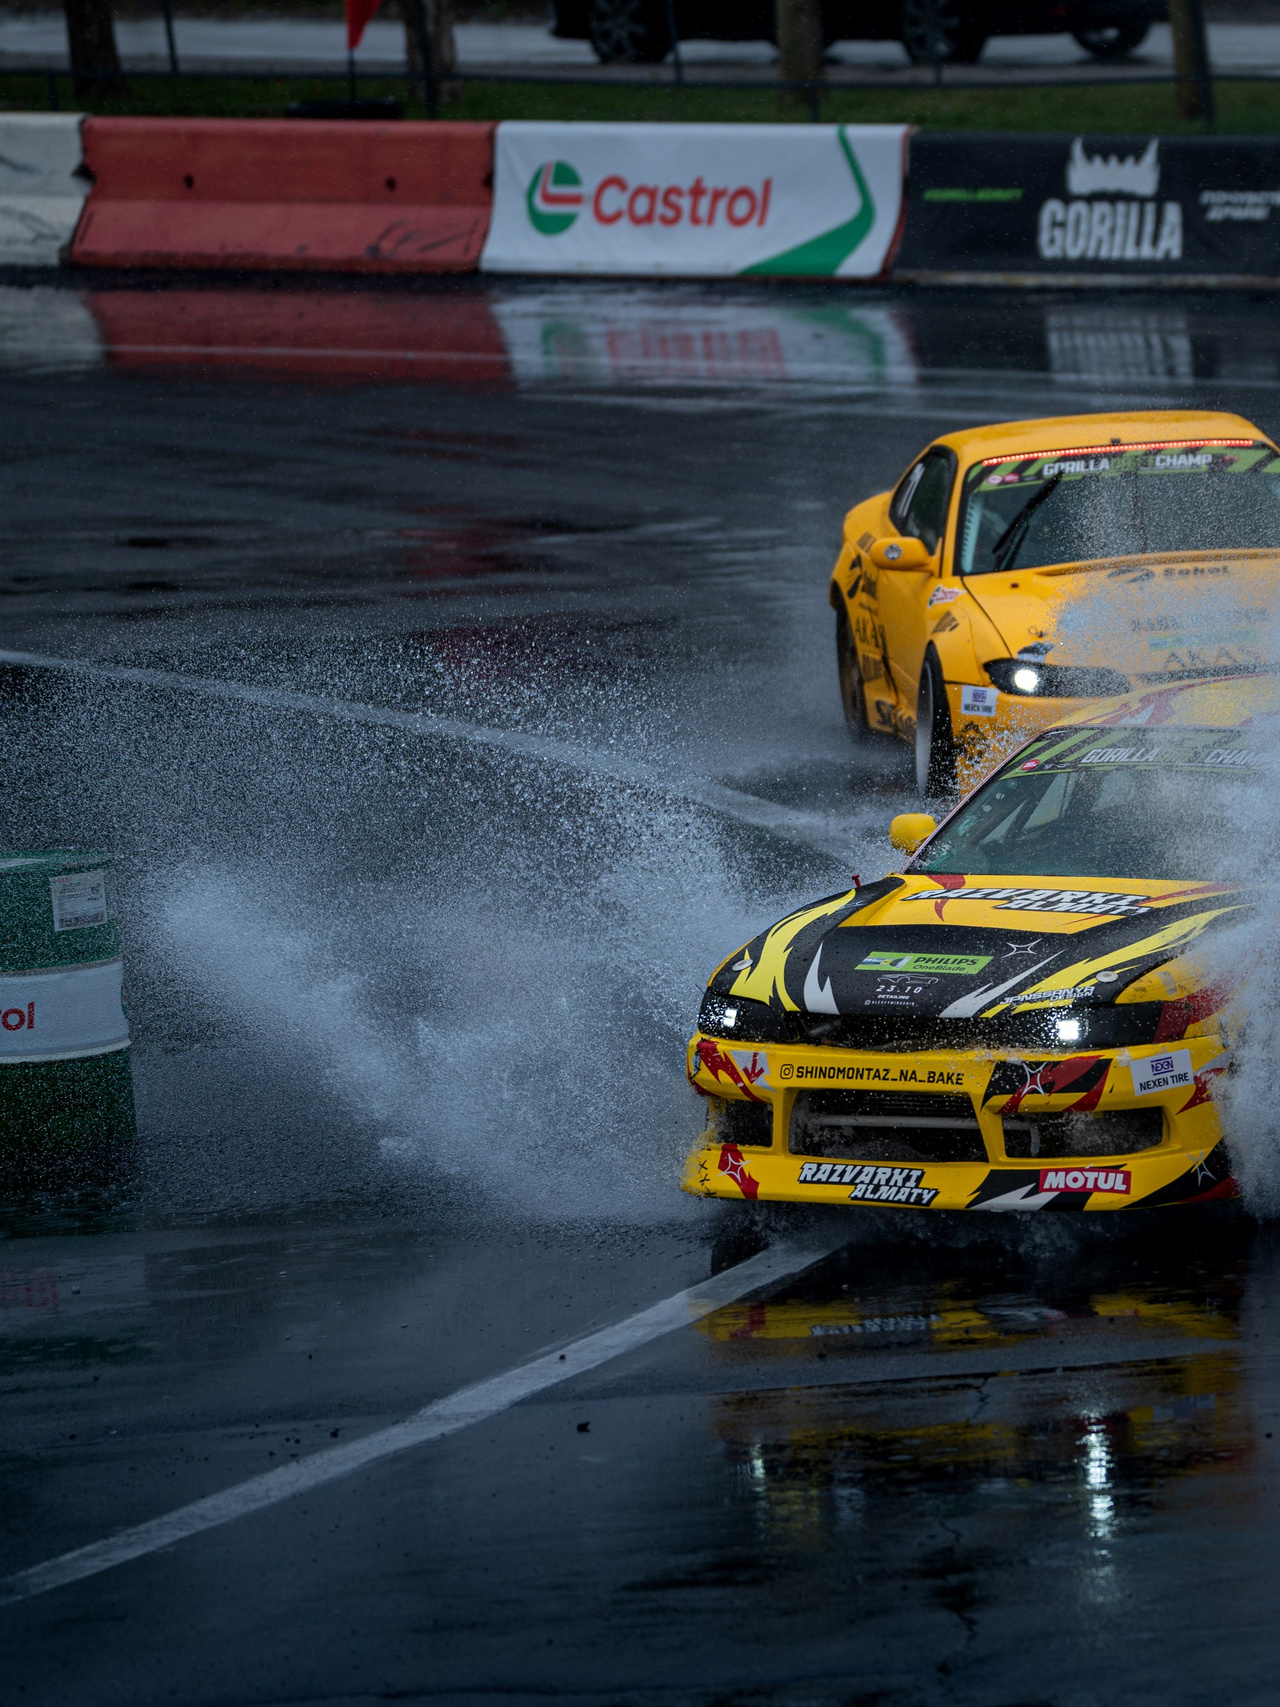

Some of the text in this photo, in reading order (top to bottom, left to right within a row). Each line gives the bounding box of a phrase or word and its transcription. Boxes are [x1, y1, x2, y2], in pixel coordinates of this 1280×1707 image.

[592, 174, 773, 228] Castrol
[1039, 200, 1181, 259] GORILLA
[1042, 457, 1110, 478] GORILLA
[1155, 454, 1212, 468] CHAMP
[1082, 746, 1160, 764] GORILLA
[907, 889, 1152, 905] RAZVARKI
[996, 900, 1150, 916] ALMATY
[913, 964, 966, 972] OneBlade
[914, 957, 980, 966] PHILIPS
[875, 984, 923, 994] 23.10
[0, 1001, 36, 1031] ol
[796, 1066, 965, 1086] SHINOMONTAZ_NA_BAKE
[1139, 1072, 1190, 1092] NEXEN TIRE
[799, 1163, 922, 1188] RAZVARKI
[1043, 1171, 1126, 1191] MOTUL
[850, 1183, 936, 1205] ALMATY
